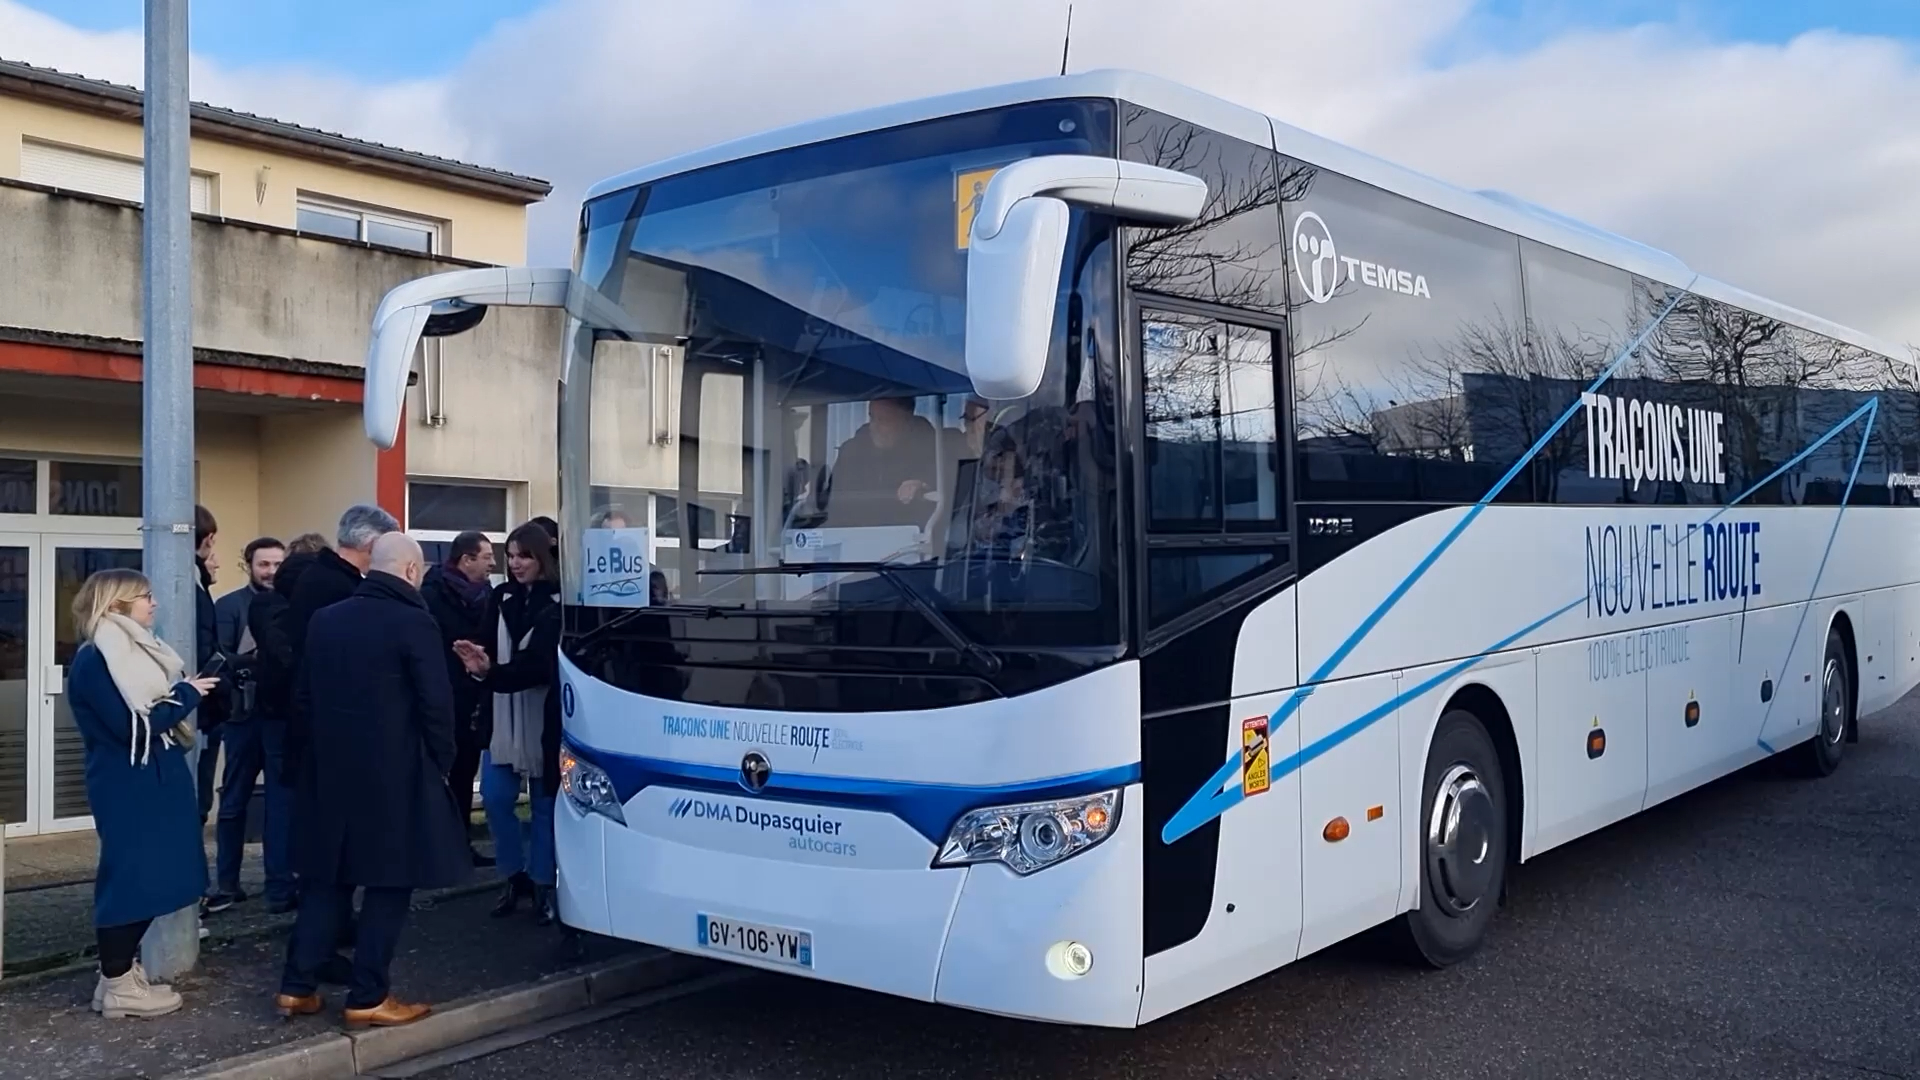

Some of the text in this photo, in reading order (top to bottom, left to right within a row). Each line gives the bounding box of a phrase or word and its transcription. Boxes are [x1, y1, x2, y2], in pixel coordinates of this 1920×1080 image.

[1341, 255, 1431, 299] TEMSA
[1582, 392, 1726, 492] TRAÇONS UNE
[609, 547, 643, 574] Bus
[1586, 521, 1762, 619] NOUVELLE ROUTE
[1587, 639, 1622, 682] 100%
[663, 715, 830, 752] TRAÇONS UNE NOUVELLE ROUTE
[693, 800, 843, 836] DMA Dupasquier
[788, 836, 857, 857] autocars
